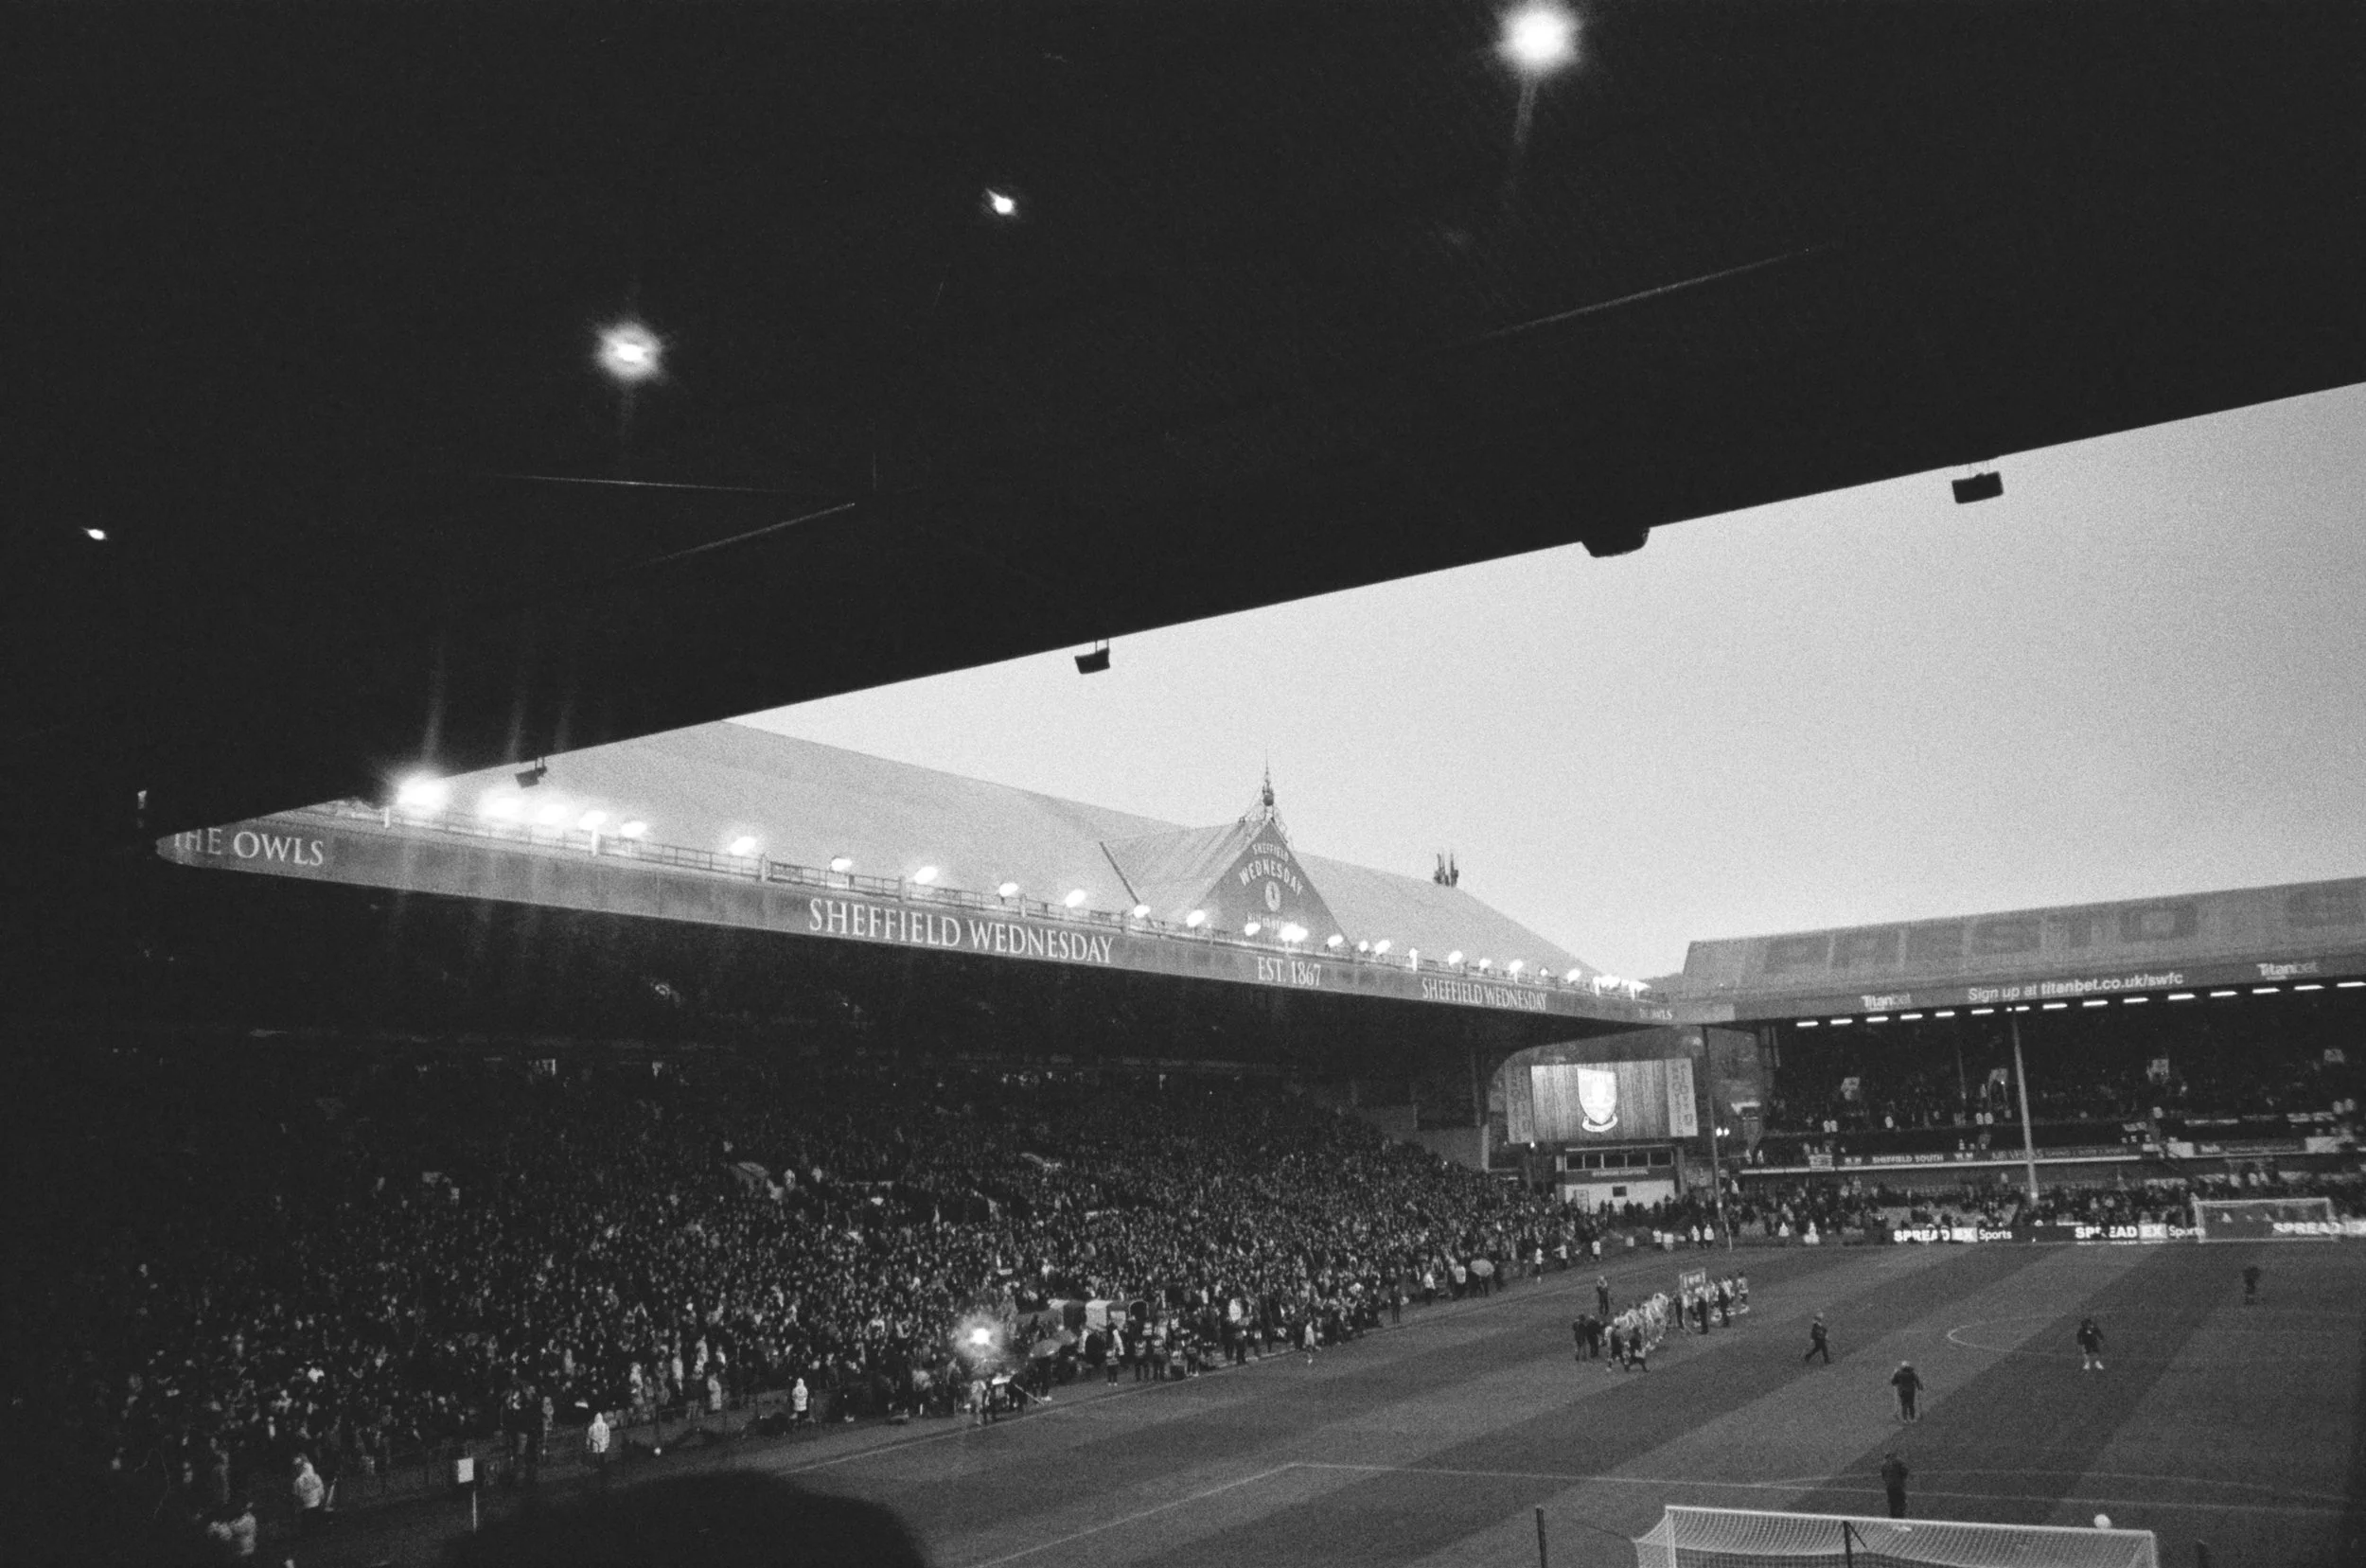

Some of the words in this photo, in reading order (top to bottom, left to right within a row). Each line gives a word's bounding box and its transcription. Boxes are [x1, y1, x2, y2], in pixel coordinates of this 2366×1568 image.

[233, 831, 324, 867] OWLS
[1239, 858, 1303, 896] WEDNESDAY
[809, 898, 962, 947] SHEFFIELD
[968, 919, 1113, 964] WEDNESDAY
[1257, 956, 1286, 982] EST.
[1292, 960, 1321, 986] 1867
[1422, 978, 1482, 1004] SHEFFIELD
[1483, 984, 1546, 1011] WEDNESDAY
[1968, 988, 1999, 1002] Sign
[2002, 986, 2021, 998] up
[2024, 983, 2038, 995] at
[2040, 972, 2184, 995] titanbet.co.uk/swfc
[1914, 1153, 1944, 1163] SOUTH
[1979, 1229, 2012, 1242] Sports
